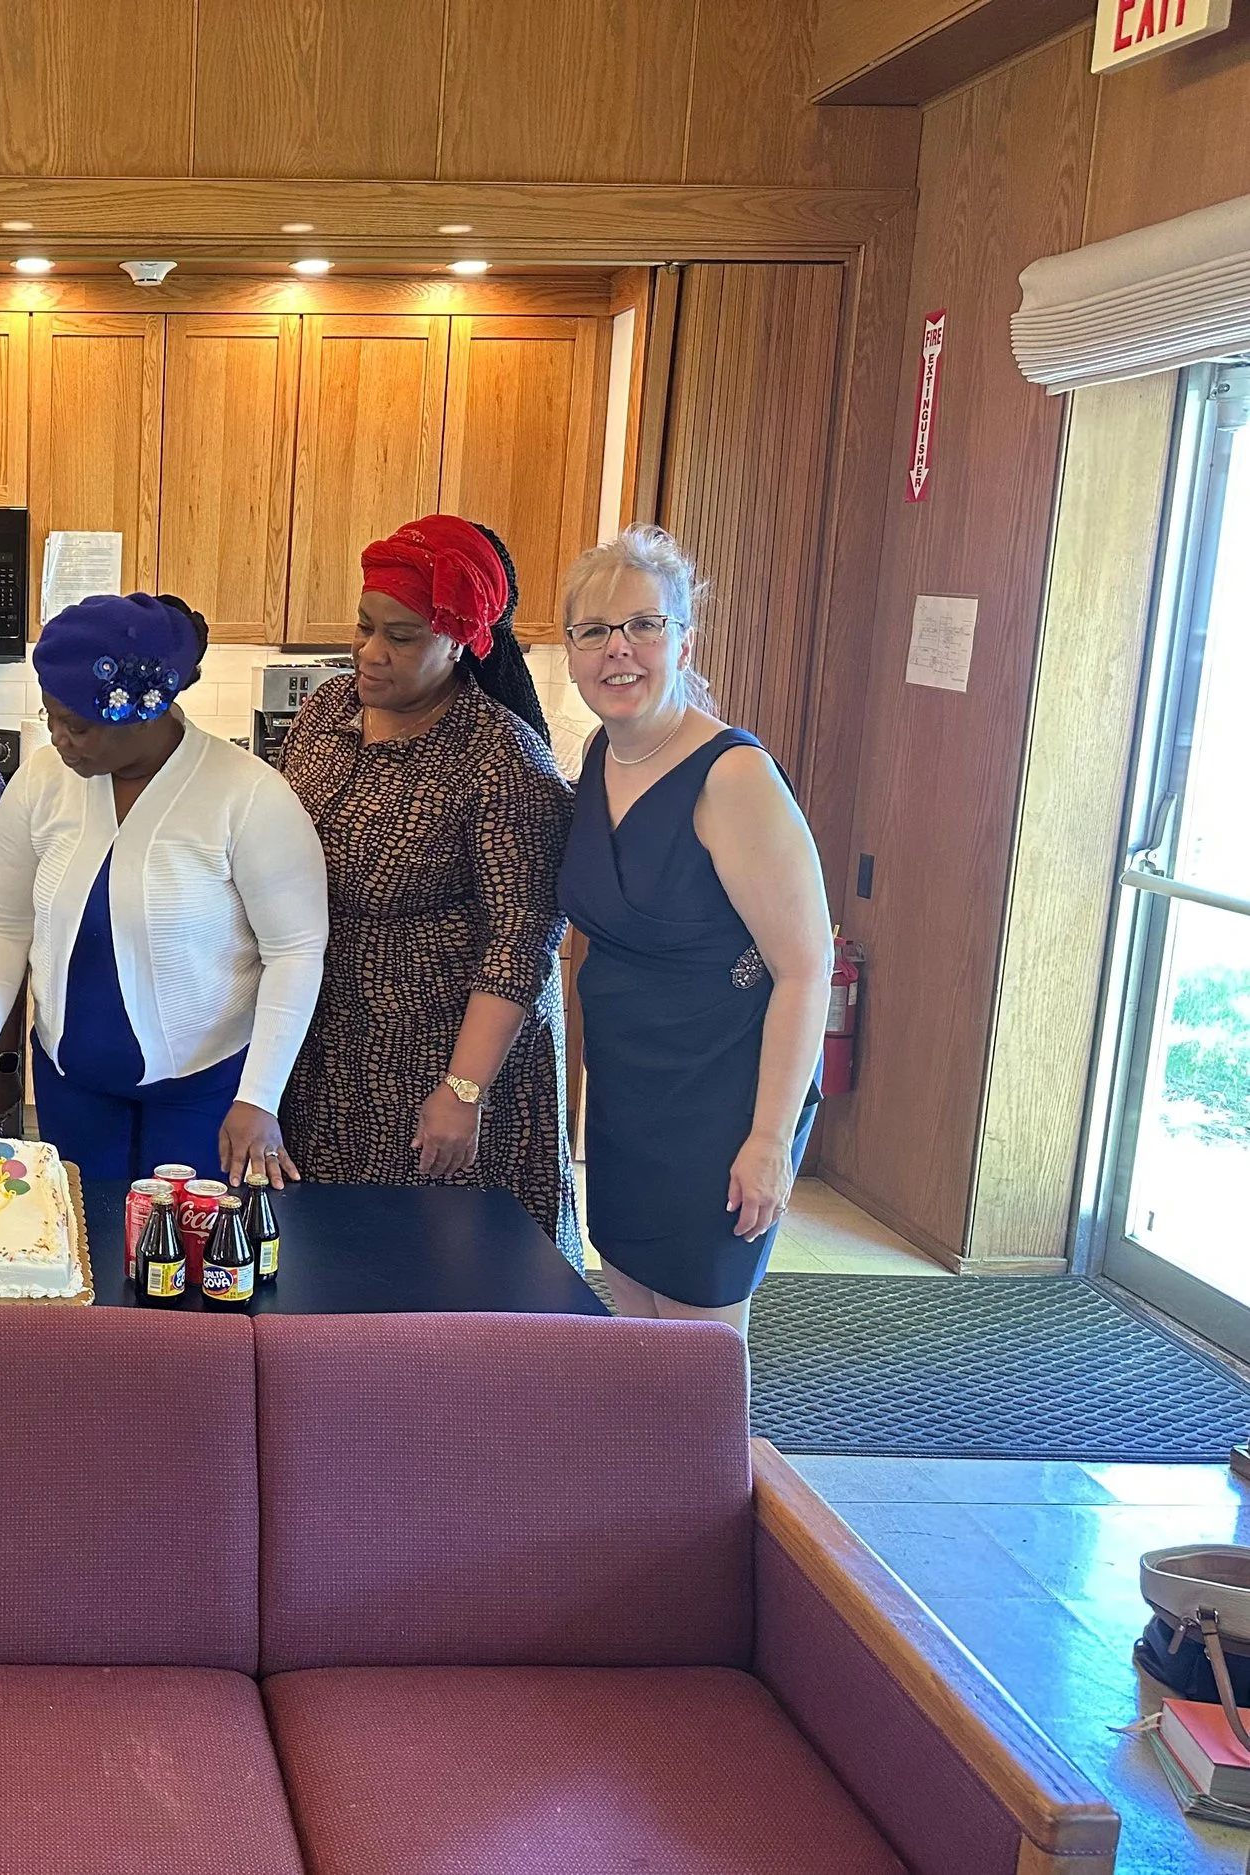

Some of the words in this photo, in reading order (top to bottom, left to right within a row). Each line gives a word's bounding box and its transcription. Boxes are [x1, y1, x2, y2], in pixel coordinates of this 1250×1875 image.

[925, 327, 942, 348] FIRE
[914, 353, 935, 488] EXTINGUISHER
[180, 1200, 219, 1230] Coca
[203, 1277, 230, 1289] GOYA
